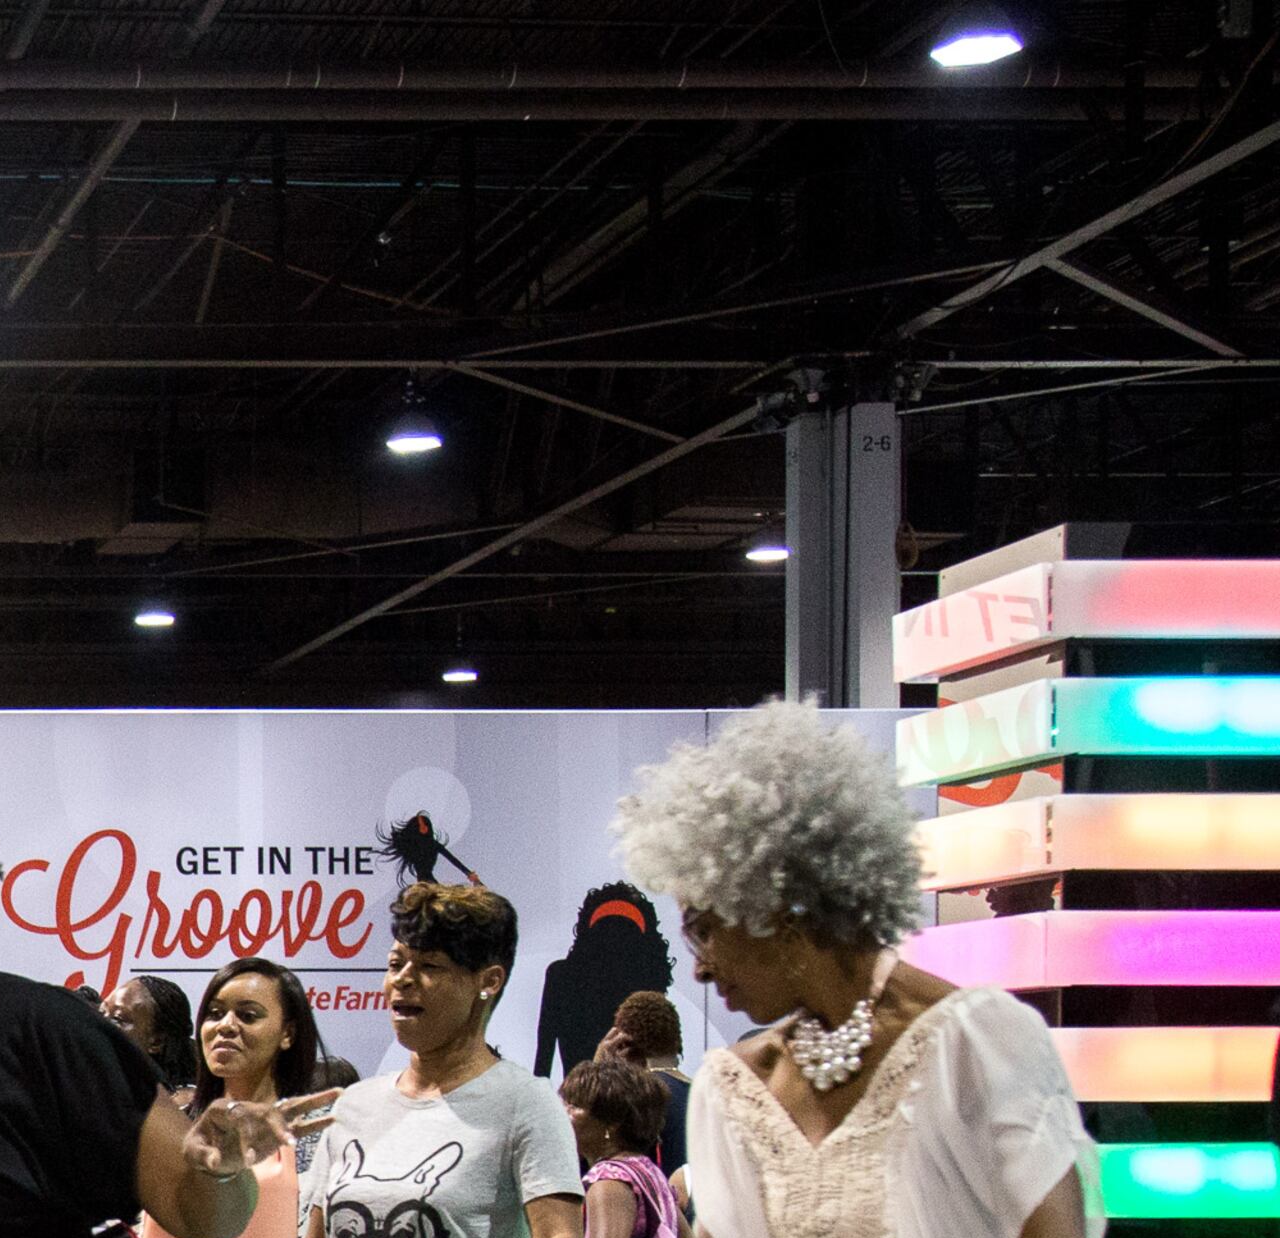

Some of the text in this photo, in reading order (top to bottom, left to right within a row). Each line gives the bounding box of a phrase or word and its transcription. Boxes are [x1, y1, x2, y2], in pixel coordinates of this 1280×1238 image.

[862, 435, 892, 452] 2-6
[175, 846, 374, 875] GET IN THE
[0, 828, 374, 1001] Groove
